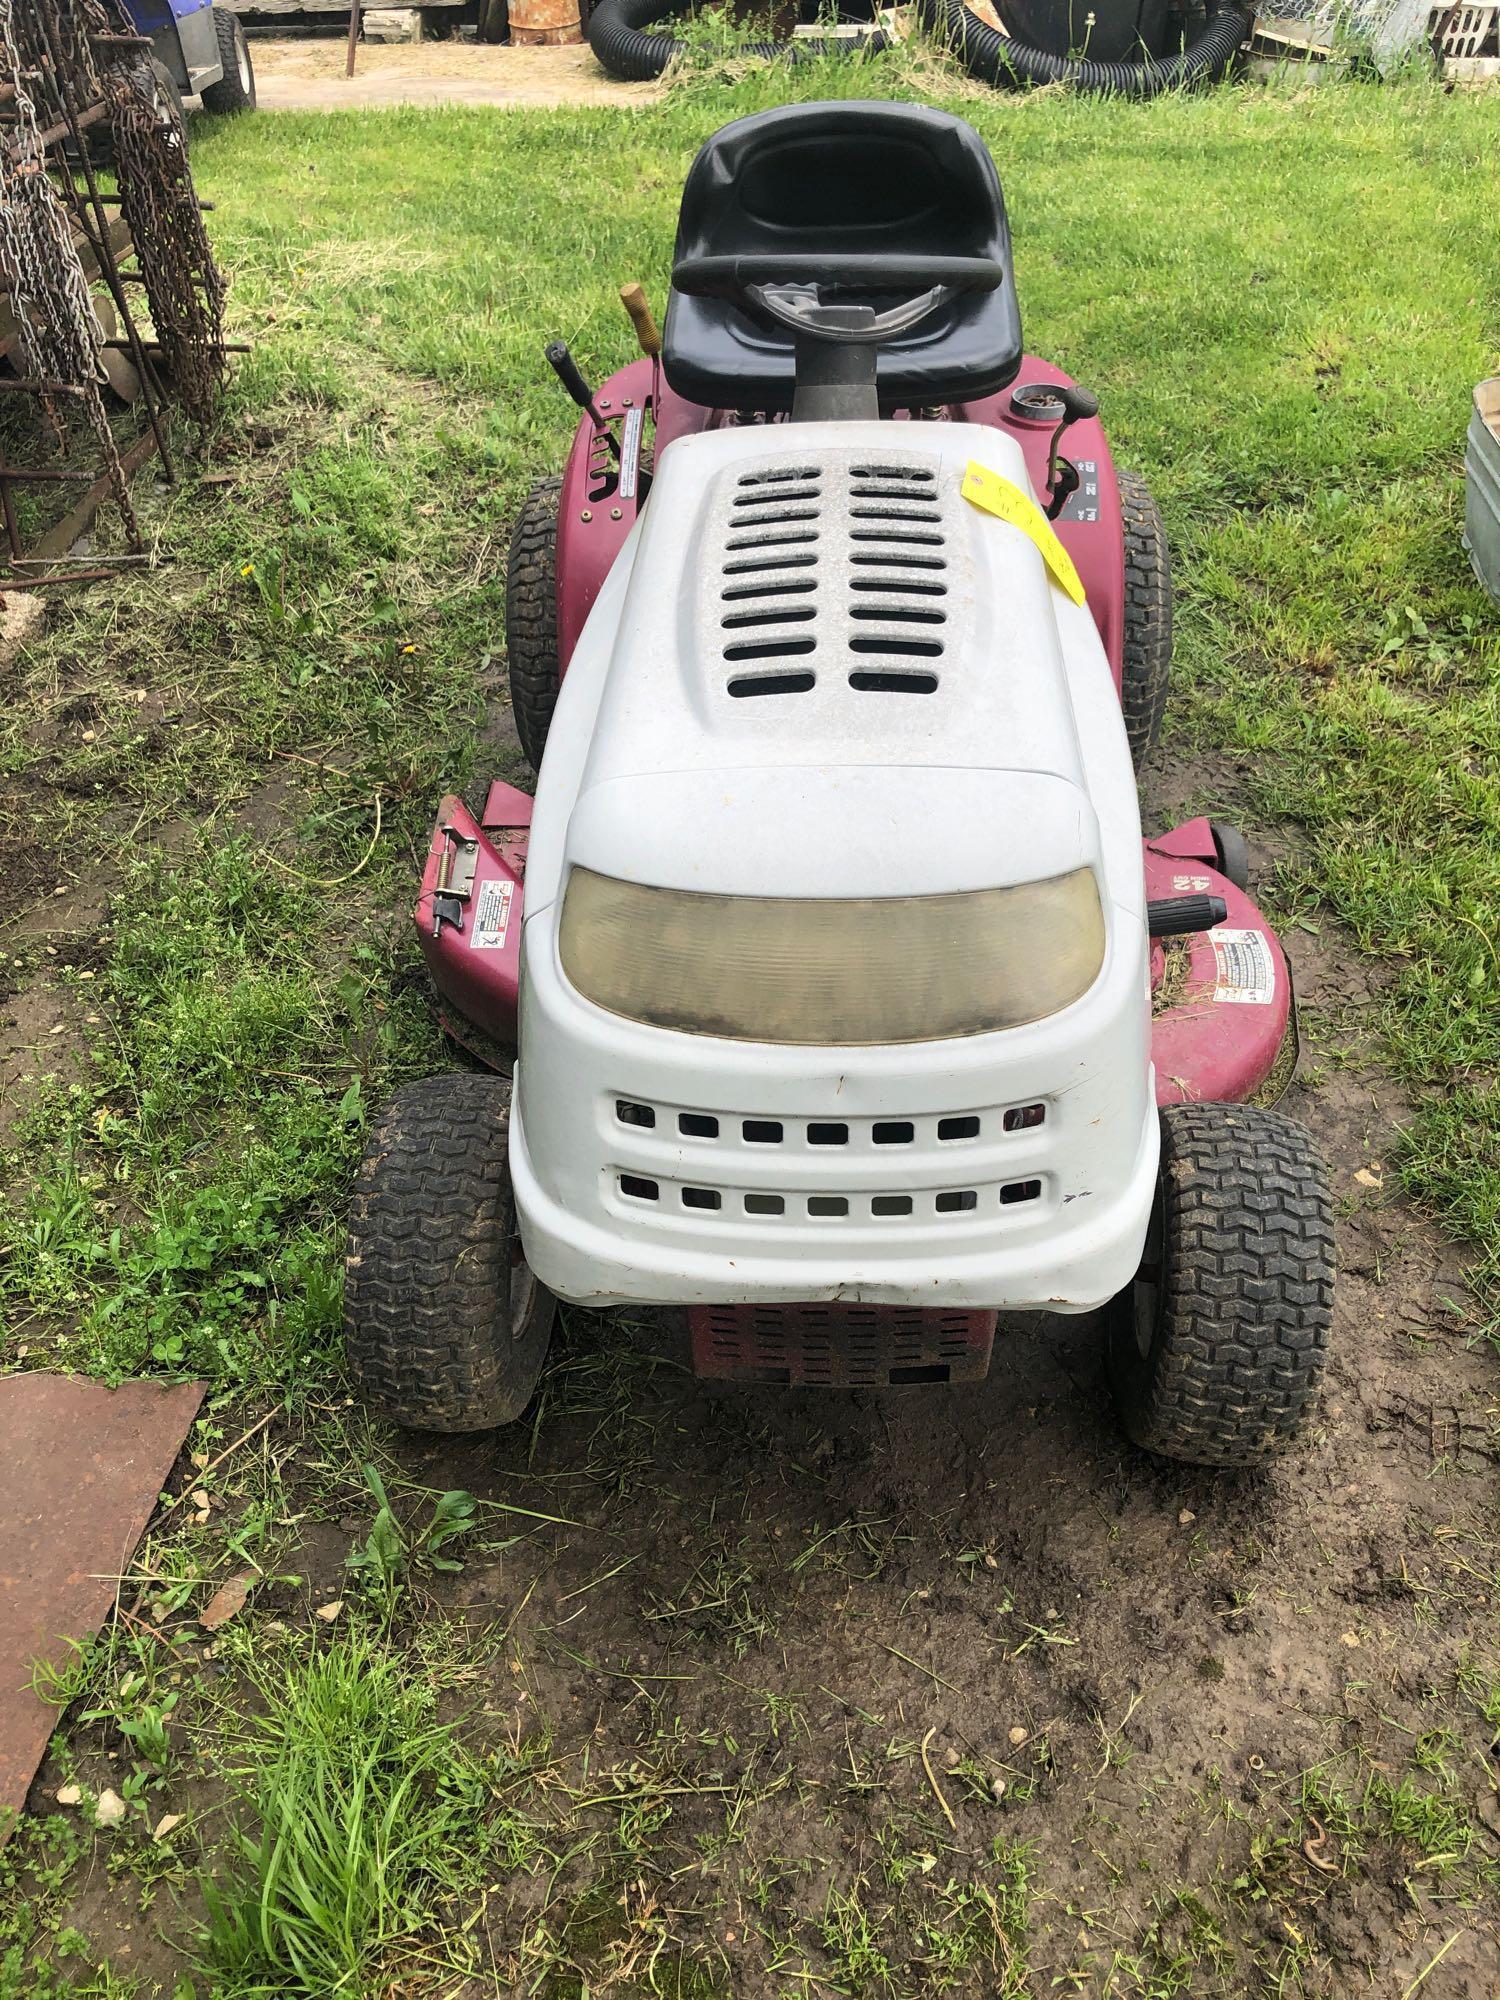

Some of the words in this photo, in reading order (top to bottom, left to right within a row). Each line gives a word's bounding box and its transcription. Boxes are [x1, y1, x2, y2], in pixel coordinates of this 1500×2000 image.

[1173, 880, 1210, 891] 42
[499, 905, 509, 928] DANGER
[1217, 950, 1228, 975] DANGER
